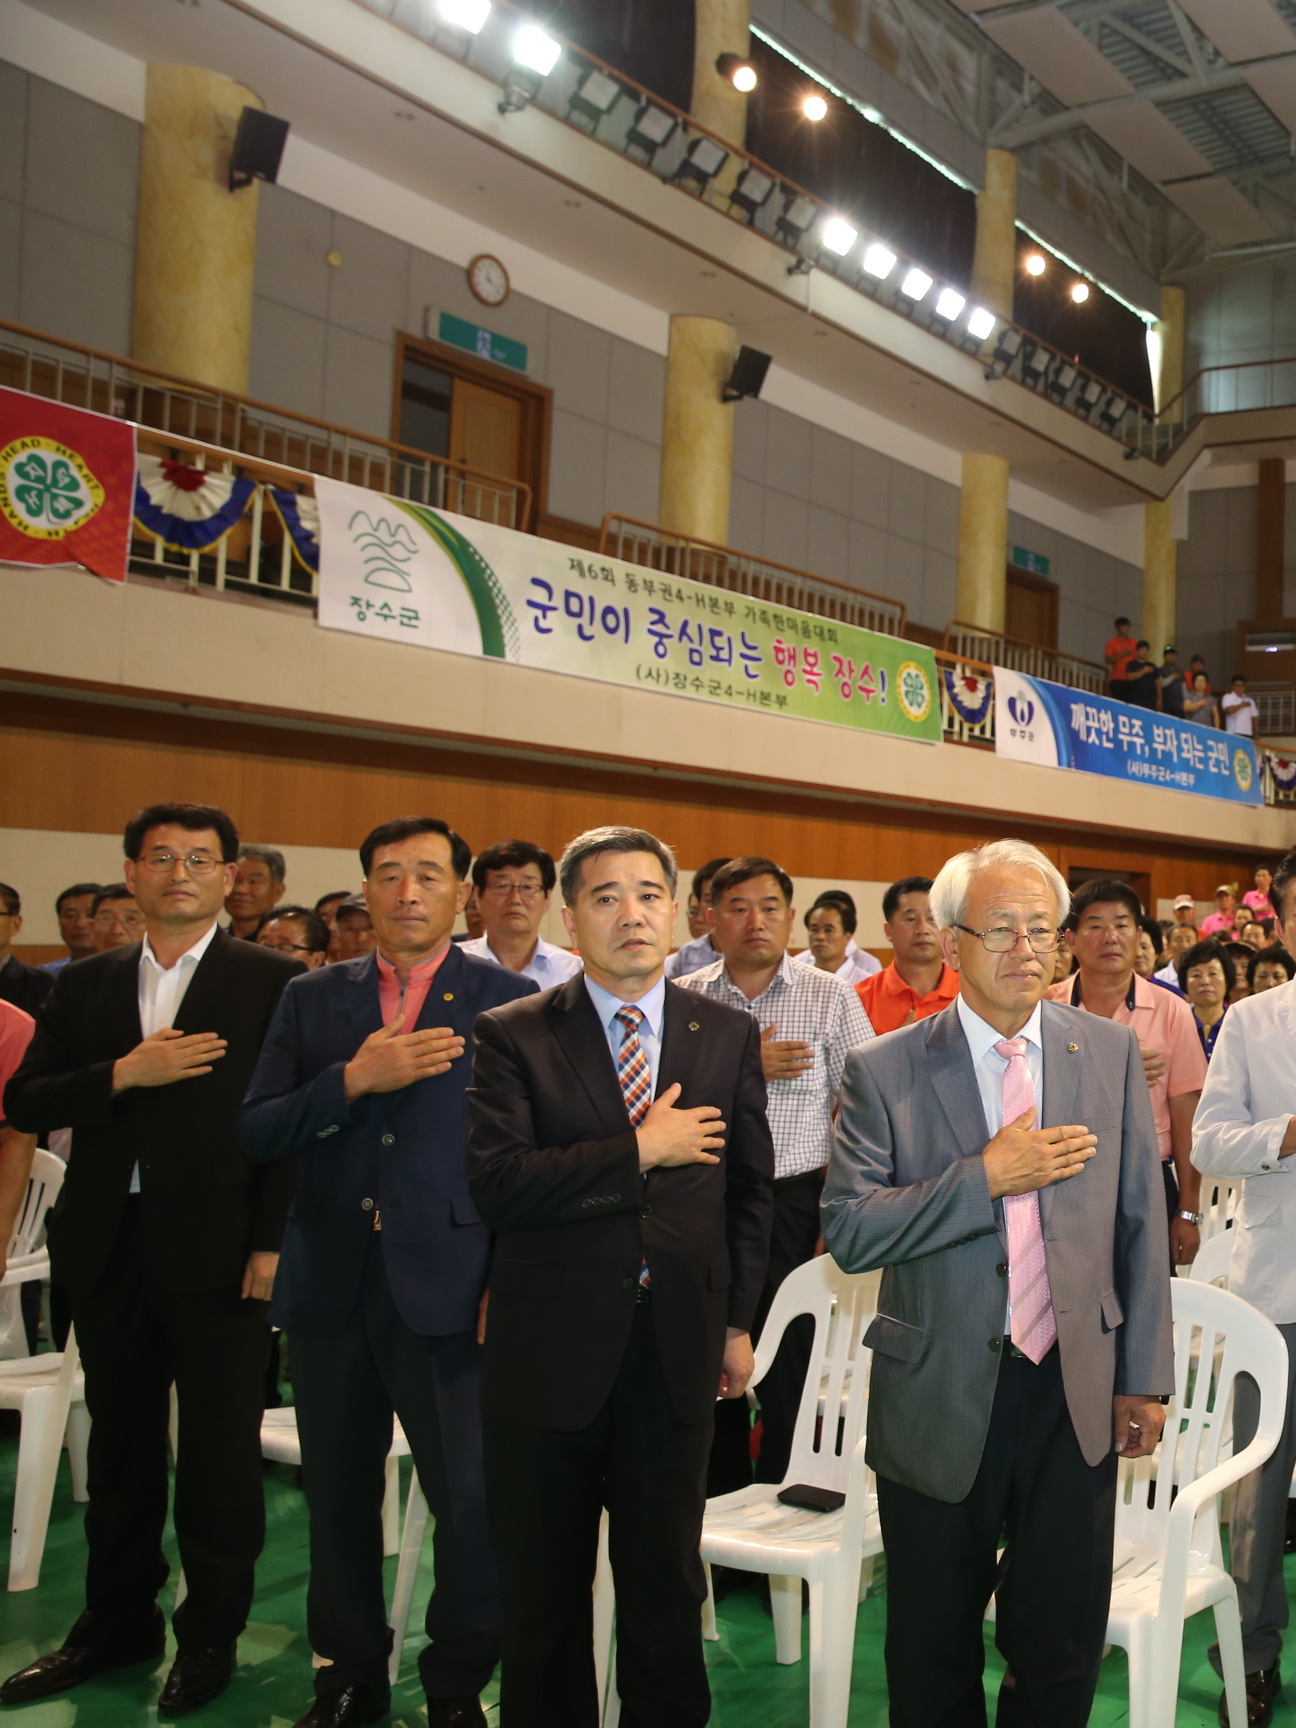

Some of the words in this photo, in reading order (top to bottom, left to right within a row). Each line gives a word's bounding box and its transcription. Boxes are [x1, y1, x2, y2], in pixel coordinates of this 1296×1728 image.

[2, 438, 41, 462] HEAD
[350, 596, 420, 629] 장수군
[568, 557, 616, 586] 제6회
[624, 572, 735, 618] 동부권4-H본부
[744, 604, 839, 645] 가족한마음대회
[526, 577, 630, 644] 군민이
[647, 606, 763, 679] 중심되는
[772, 637, 823, 694] 행복
[831, 654, 888, 705] 장수!
[636, 663, 788, 709] (사)장수군4-H본부
[1070, 702, 1115, 749] 깨끗한
[1117, 714, 1150, 758] 무주,
[1152, 724, 1178, 763] 부자
[1180, 731, 1205, 770] 되는
[1206, 739, 1230, 775] 군민
